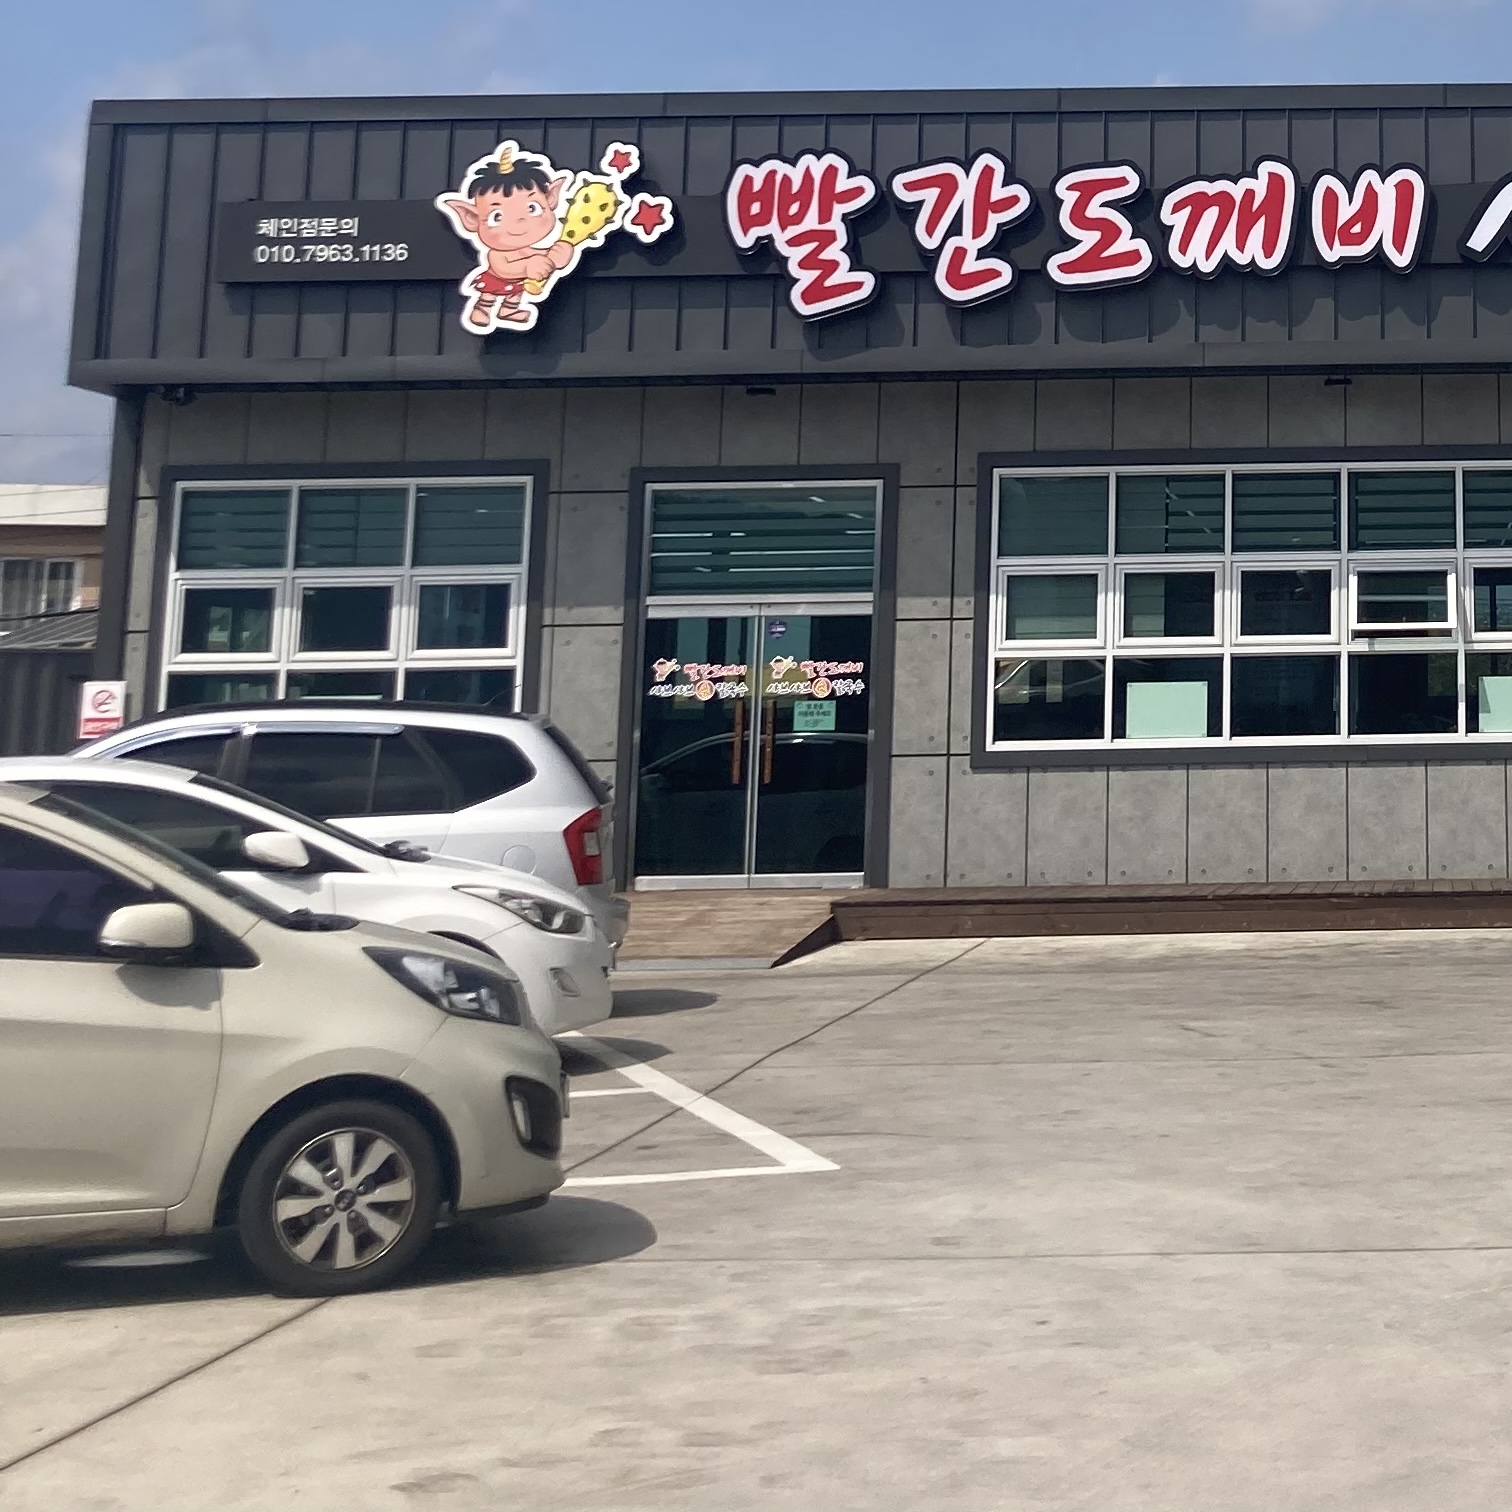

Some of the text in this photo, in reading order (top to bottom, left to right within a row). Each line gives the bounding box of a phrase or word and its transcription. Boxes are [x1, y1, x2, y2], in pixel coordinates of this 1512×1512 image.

[255, 217, 359, 237] 체인점문의
[729, 151, 1427, 317] 빨간도깨비
[254, 243, 409, 263] 010.7963.1136
